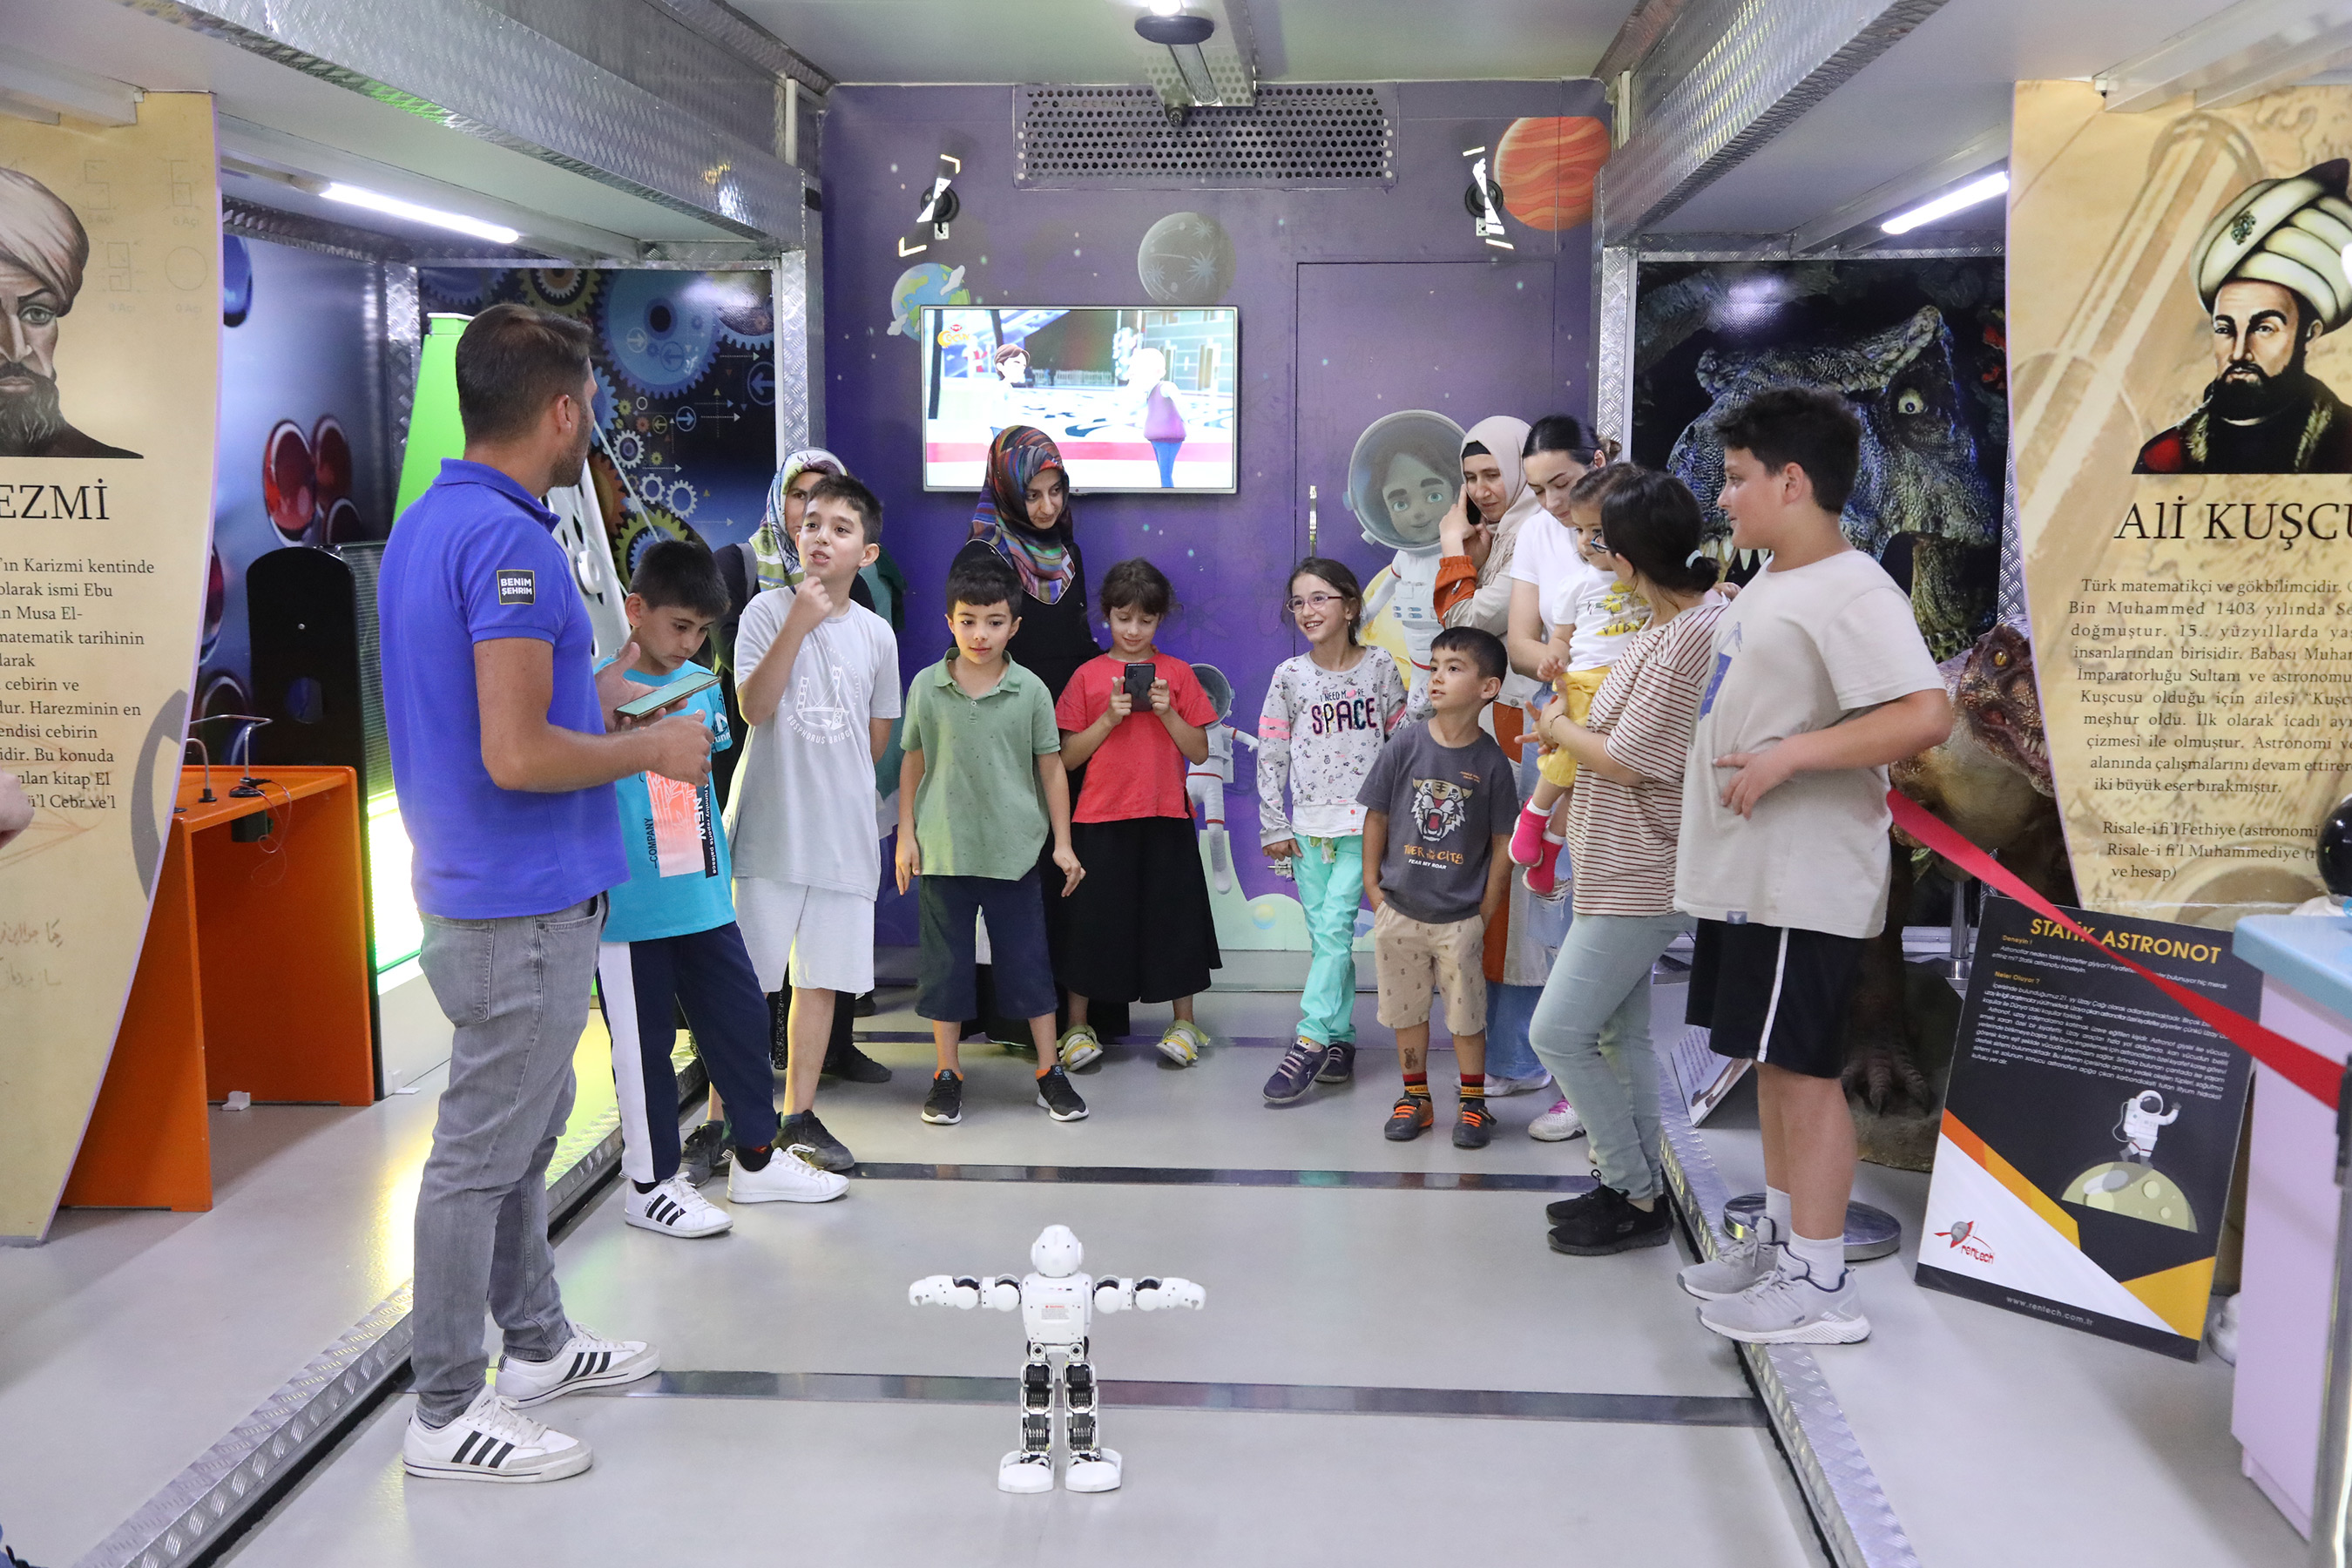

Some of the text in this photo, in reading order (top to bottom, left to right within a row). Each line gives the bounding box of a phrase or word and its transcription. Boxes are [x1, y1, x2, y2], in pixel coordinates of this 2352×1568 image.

[2204, 502, 2352, 551] KUŞC
[24, 558, 84, 572] Karizmi
[88, 558, 154, 573] kentinde
[48, 582, 79, 597] ismi
[84, 583, 113, 597] Ebu
[2081, 578, 2342, 596] Türk matematikçi ve gökbilimcidir.
[17, 605, 57, 619] Musa
[61, 606, 83, 620] El-
[2069, 601, 2096, 614] Bin
[2107, 601, 2206, 614] Muhammed
[2217, 602, 2255, 615] 1403
[2266, 602, 2325, 618] yılında
[78, 632, 145, 645] tarihinin
[2071, 624, 2167, 640] doğmuştur.
[2220, 625, 2318, 641] yüzyıllarda
[2074, 645, 2173, 659] insanlarından
[2181, 646, 2242, 659] birisidir.
[2250, 646, 2296, 660] Babası
[5, 677, 79, 691] cebirin ve
[2077, 666, 2182, 685] İmparatorluğu
[2190, 668, 2240, 682] Sultanı
[2249, 672, 2265, 682] ve
[1324, 692, 1340, 701] NEED
[2080, 690, 2143, 706] Kuşcusu
[2153, 691, 2206, 707] olduğu
[2216, 692, 2244, 706] için
[2254, 692, 2295, 704] ailesi
[30, 701, 118, 715] Harezminin
[123, 706, 141, 715] en
[1311, 698, 1377, 735] SPACE
[2084, 712, 2139, 727] meşhur
[2148, 713, 2186, 725] oldu.
[2197, 711, 2217, 726] İlk
[2227, 713, 2274, 727] olarak
[2284, 714, 2320, 727] icadı
[45, 725, 98, 738] cebirin
[787, 714, 826, 745] BOSPHORUS
[2086, 734, 2140, 749] çizmesi
[2148, 734, 2166, 747] ile
[2174, 735, 2244, 750] olmuştur.
[2253, 736, 2332, 749] Astronomi
[35, 748, 54, 761] Bu
[59, 748, 114, 762] konuda
[2091, 755, 2352, 773] alanında çalışmalarını devam ettirer
[53, 771, 91, 788] kitap
[95, 772, 111, 785] El
[2094, 778, 2281, 795] iki büyük eser bırakmıştır.
[50, 794, 85, 808] Cebr
[90, 795, 116, 808] ve’l
[693, 797, 706, 840] NEW
[2103, 821, 2157, 835] Risale-i
[2181, 822, 2236, 839] Fethiye
[2239, 823, 2319, 838] (astronomi
[645, 818, 658, 862] COMPANY
[2108, 842, 2160, 856] Risale-i
[2189, 844, 2300, 862] Muhammediye
[2112, 864, 2177, 882] ve hesap)
[2101, 930, 2221, 963] ASTRONOT
[1961, 1245, 1994, 1264] rentech
[2006, 1295, 2093, 1327] www.rentech.com.tr
